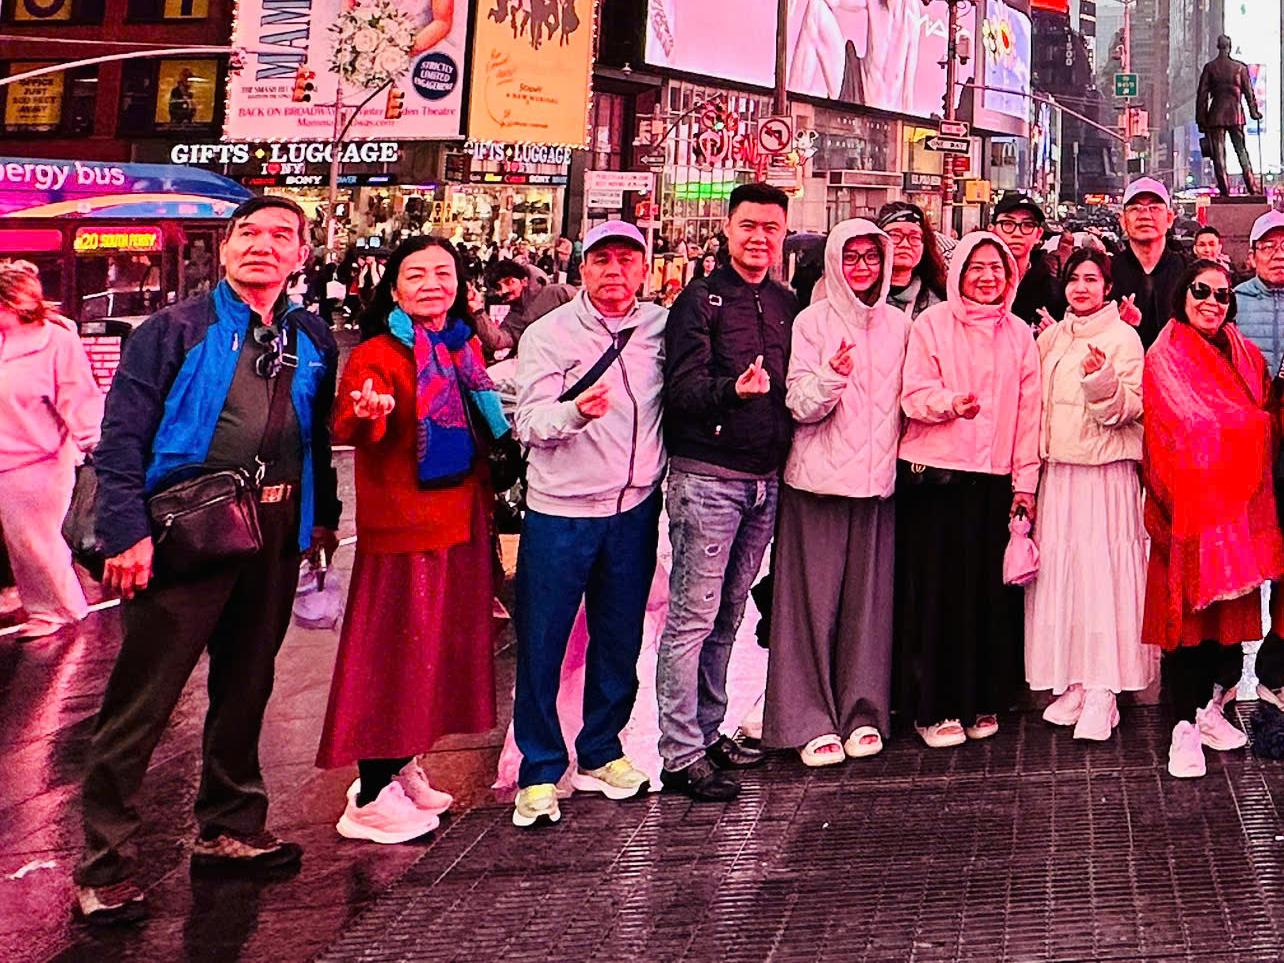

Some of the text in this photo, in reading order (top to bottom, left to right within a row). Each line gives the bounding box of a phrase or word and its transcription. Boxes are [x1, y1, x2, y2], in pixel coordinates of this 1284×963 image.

[421, 61, 453, 73] STRICTLY
[420, 69, 450, 82] LIMITED
[239, 108, 264, 117] BACK
[267, 108, 281, 117] ON
[170, 142, 398, 164] GIFTS LUGGAGE
[464, 141, 572, 165] GIFTS LUGGAGE
[74, 161, 125, 186] bus
[285, 176, 323, 185] SONY
